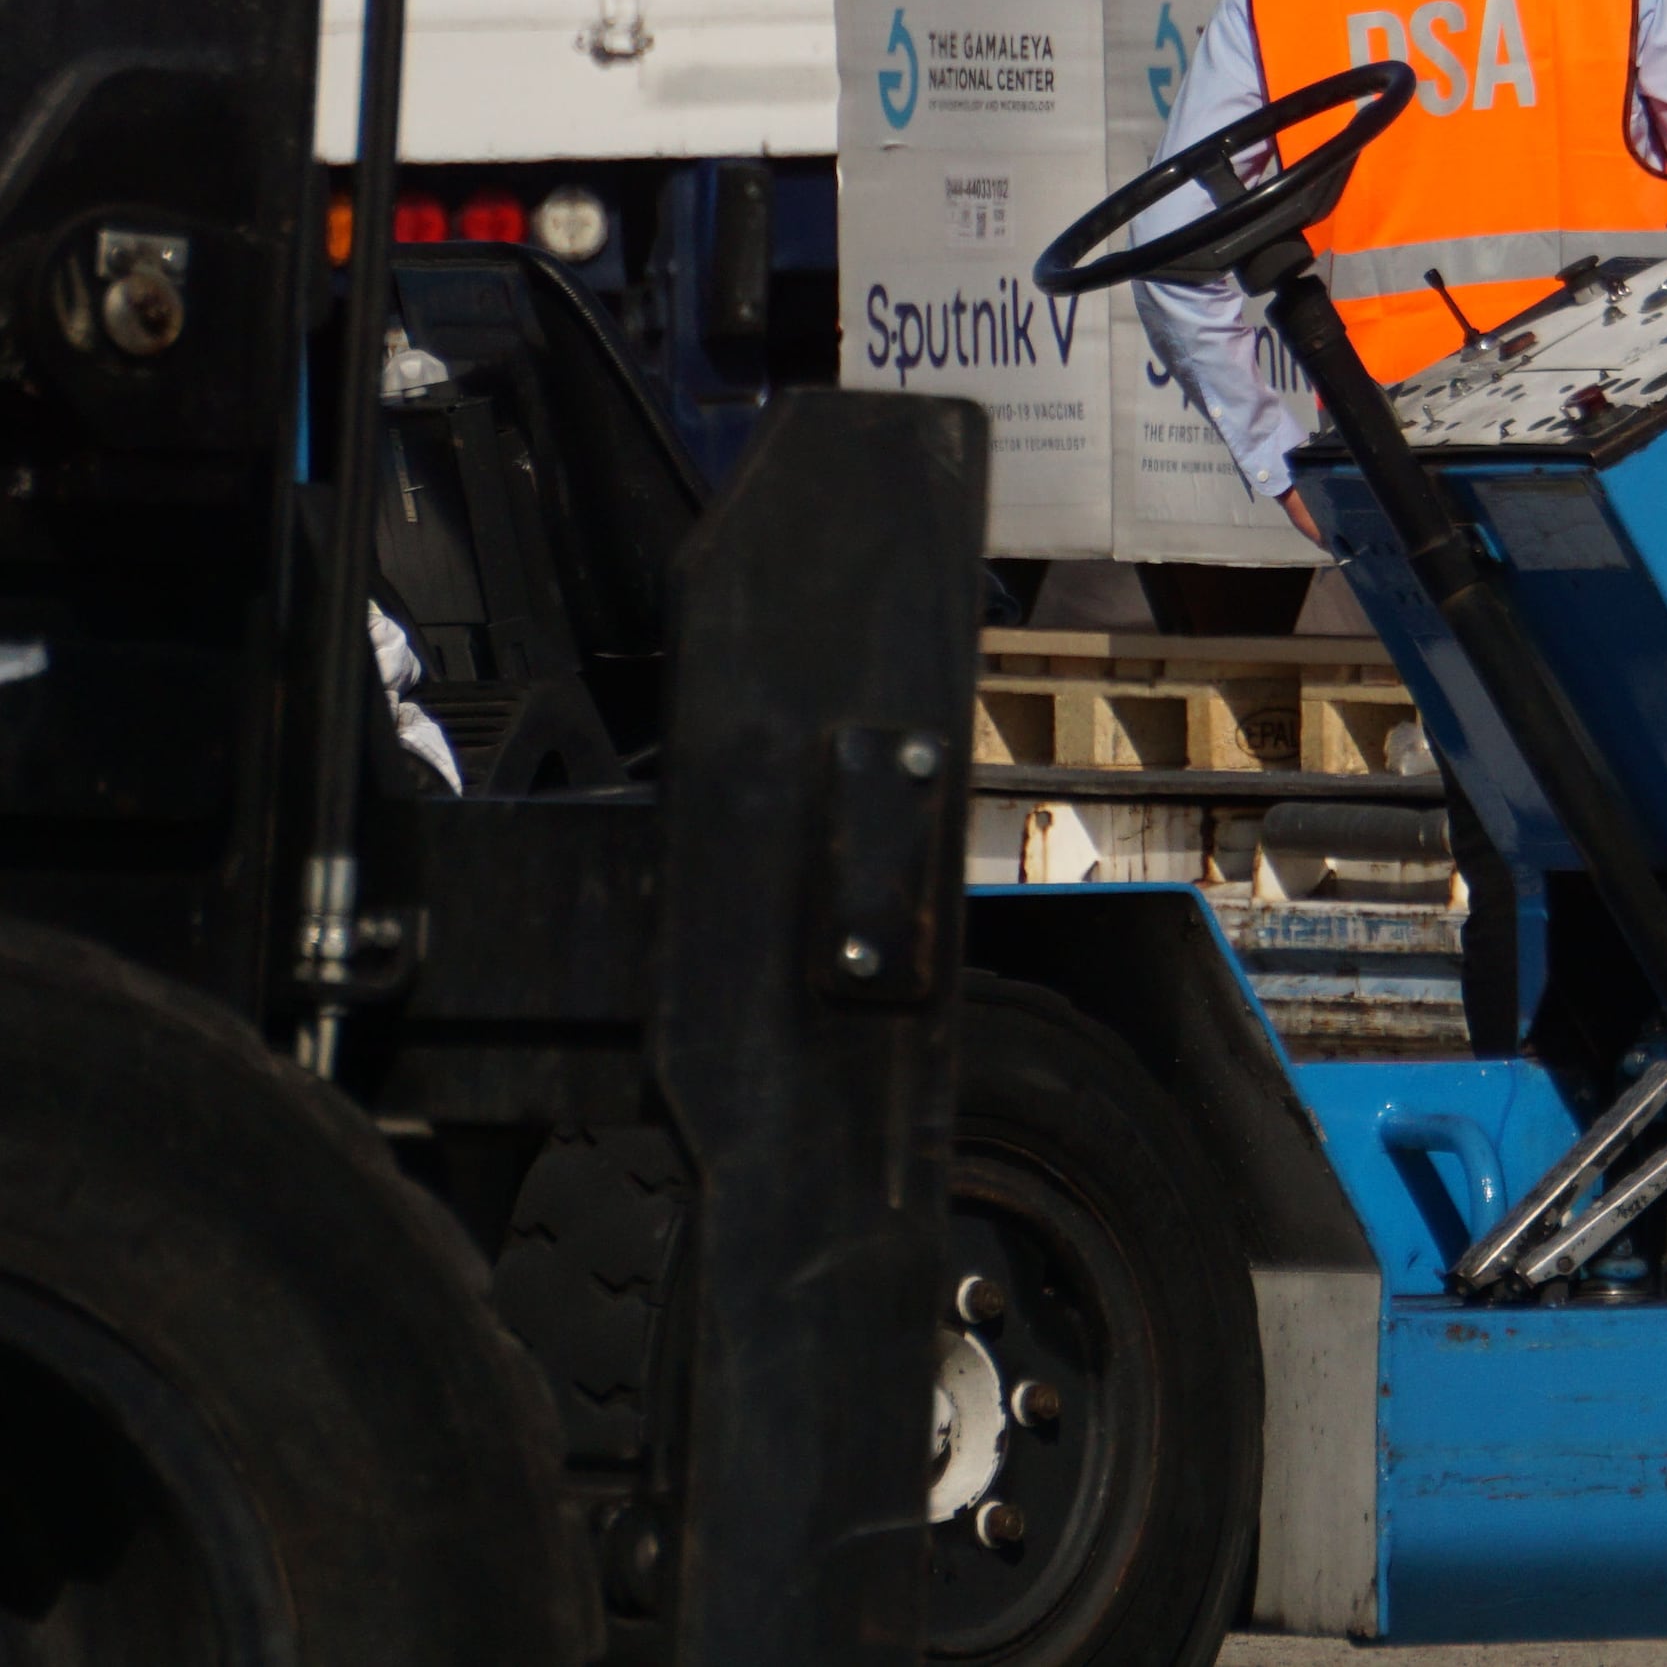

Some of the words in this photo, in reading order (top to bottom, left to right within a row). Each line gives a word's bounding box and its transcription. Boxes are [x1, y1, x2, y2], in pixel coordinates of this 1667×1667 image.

[928, 32, 957, 58] THE
[963, 34, 1055, 61] GAMALEYA
[928, 67, 994, 91] NATIONAL
[997, 69, 1056, 93] CENTER
[867, 277, 1036, 388] Sputnik
[1048, 293, 1079, 368] V
[1033, 400, 1084, 423] VACCINE
[1144, 422, 1164, 443] THE
[1168, 424, 1201, 444] FIRST
[1246, 720, 1300, 749] EPAL
